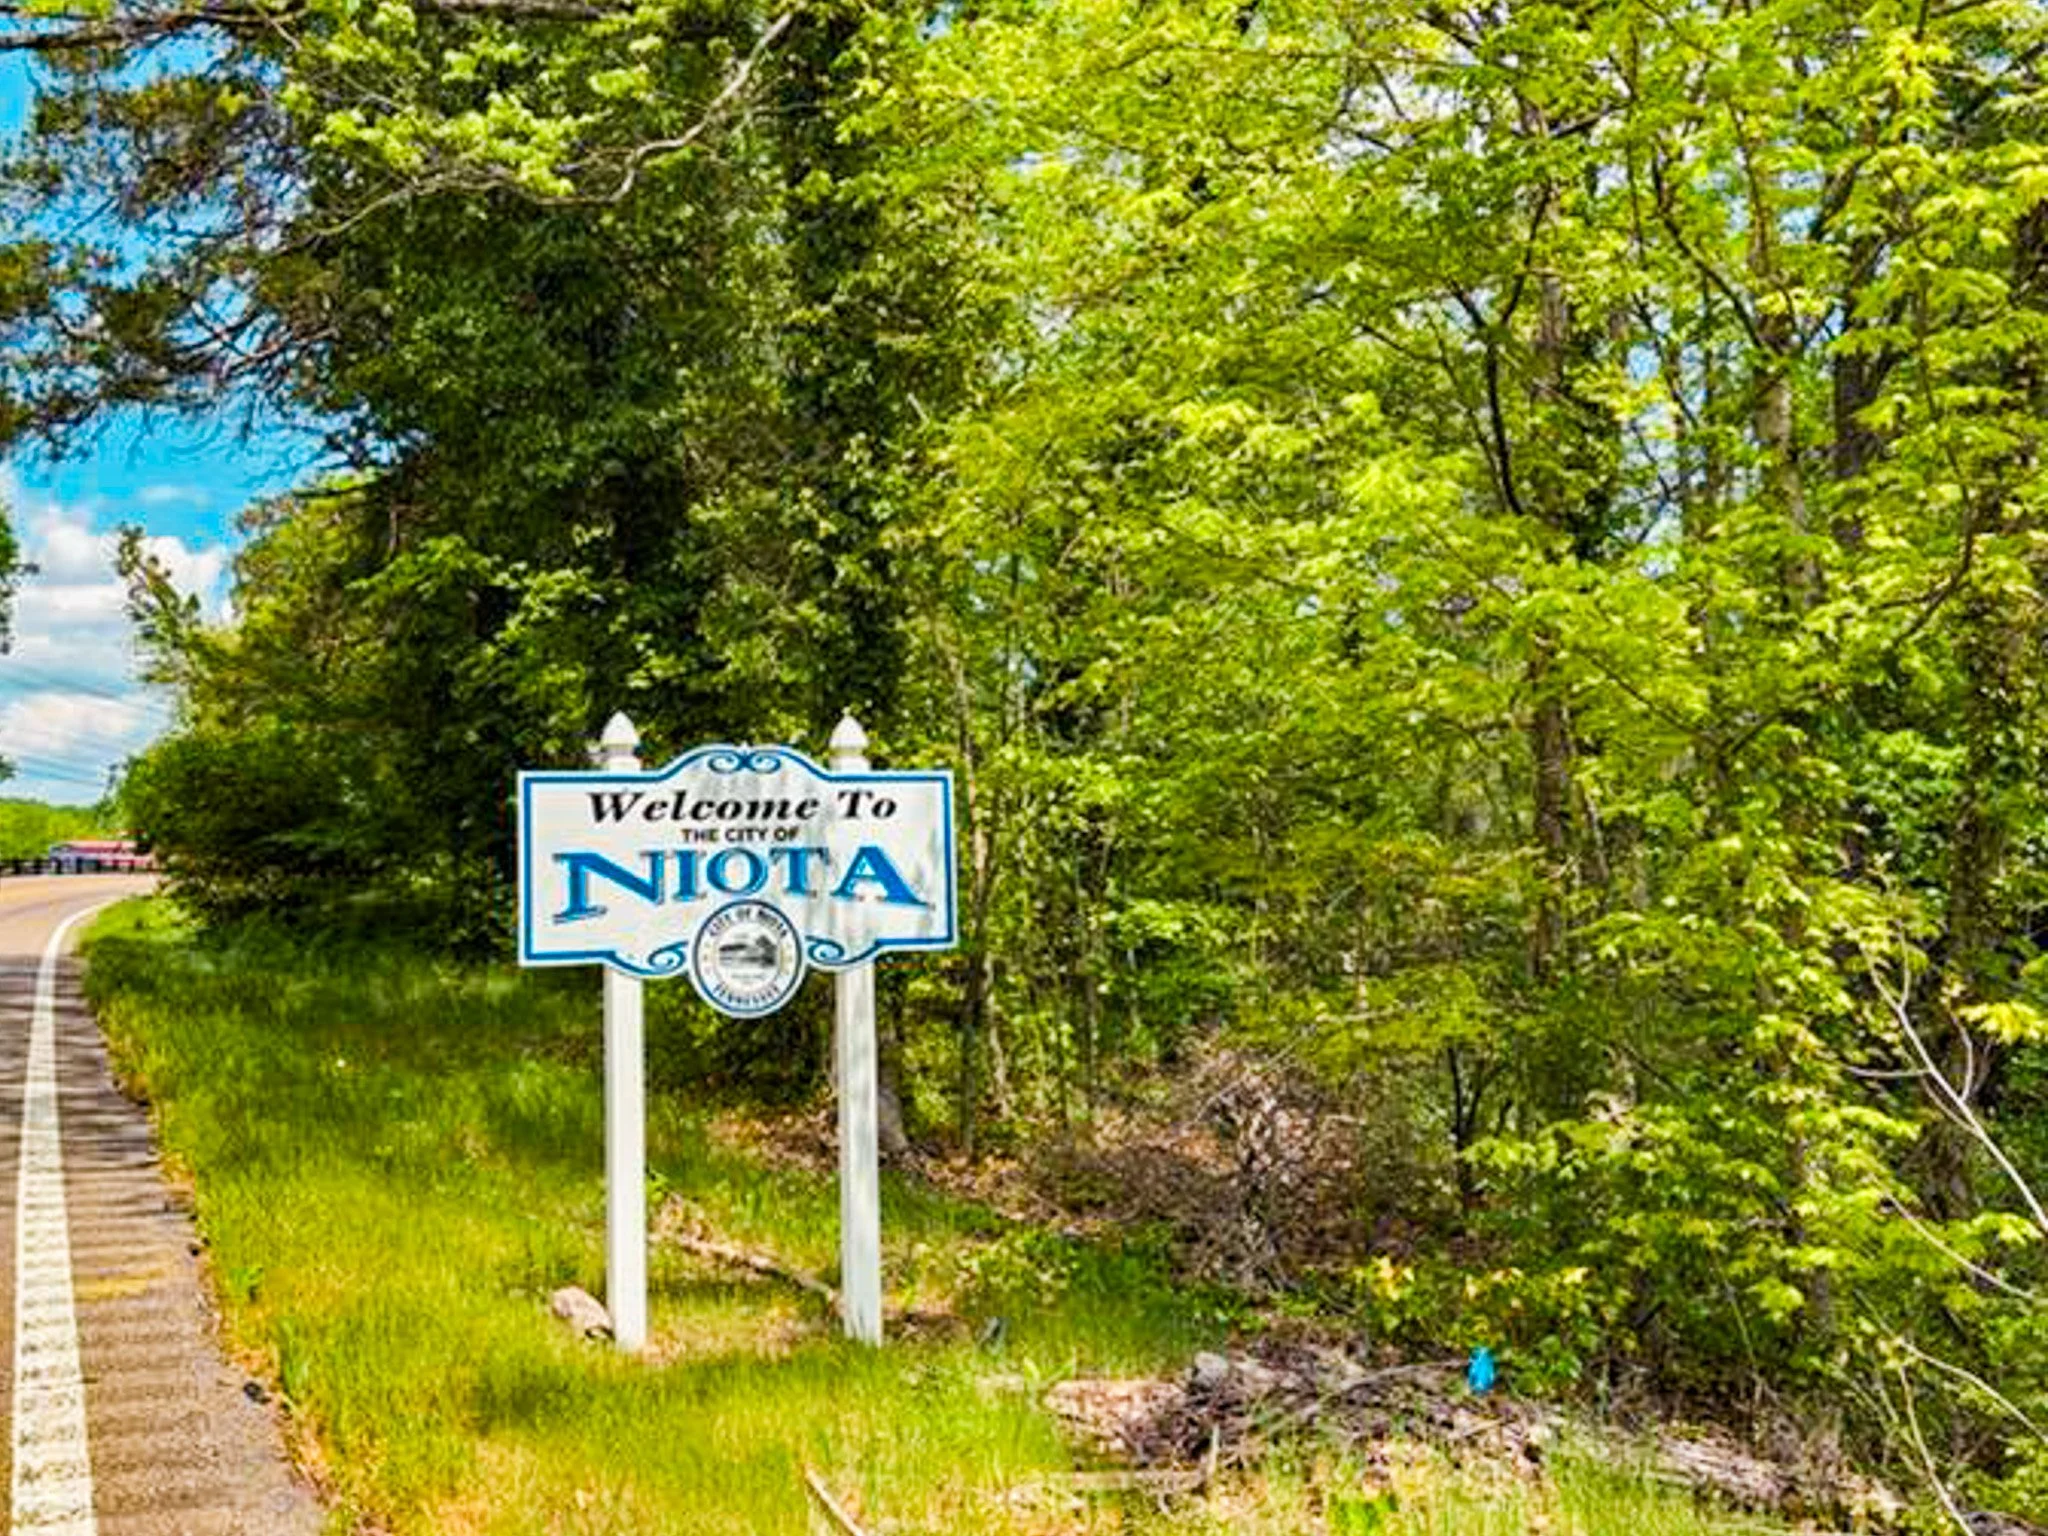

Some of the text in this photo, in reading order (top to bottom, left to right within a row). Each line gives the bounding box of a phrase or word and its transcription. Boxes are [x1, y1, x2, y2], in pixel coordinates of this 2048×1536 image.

[587, 788, 897, 823] Welcome To
[681, 826, 800, 844] THE CITY OF
[552, 844, 936, 925] NIOTA
